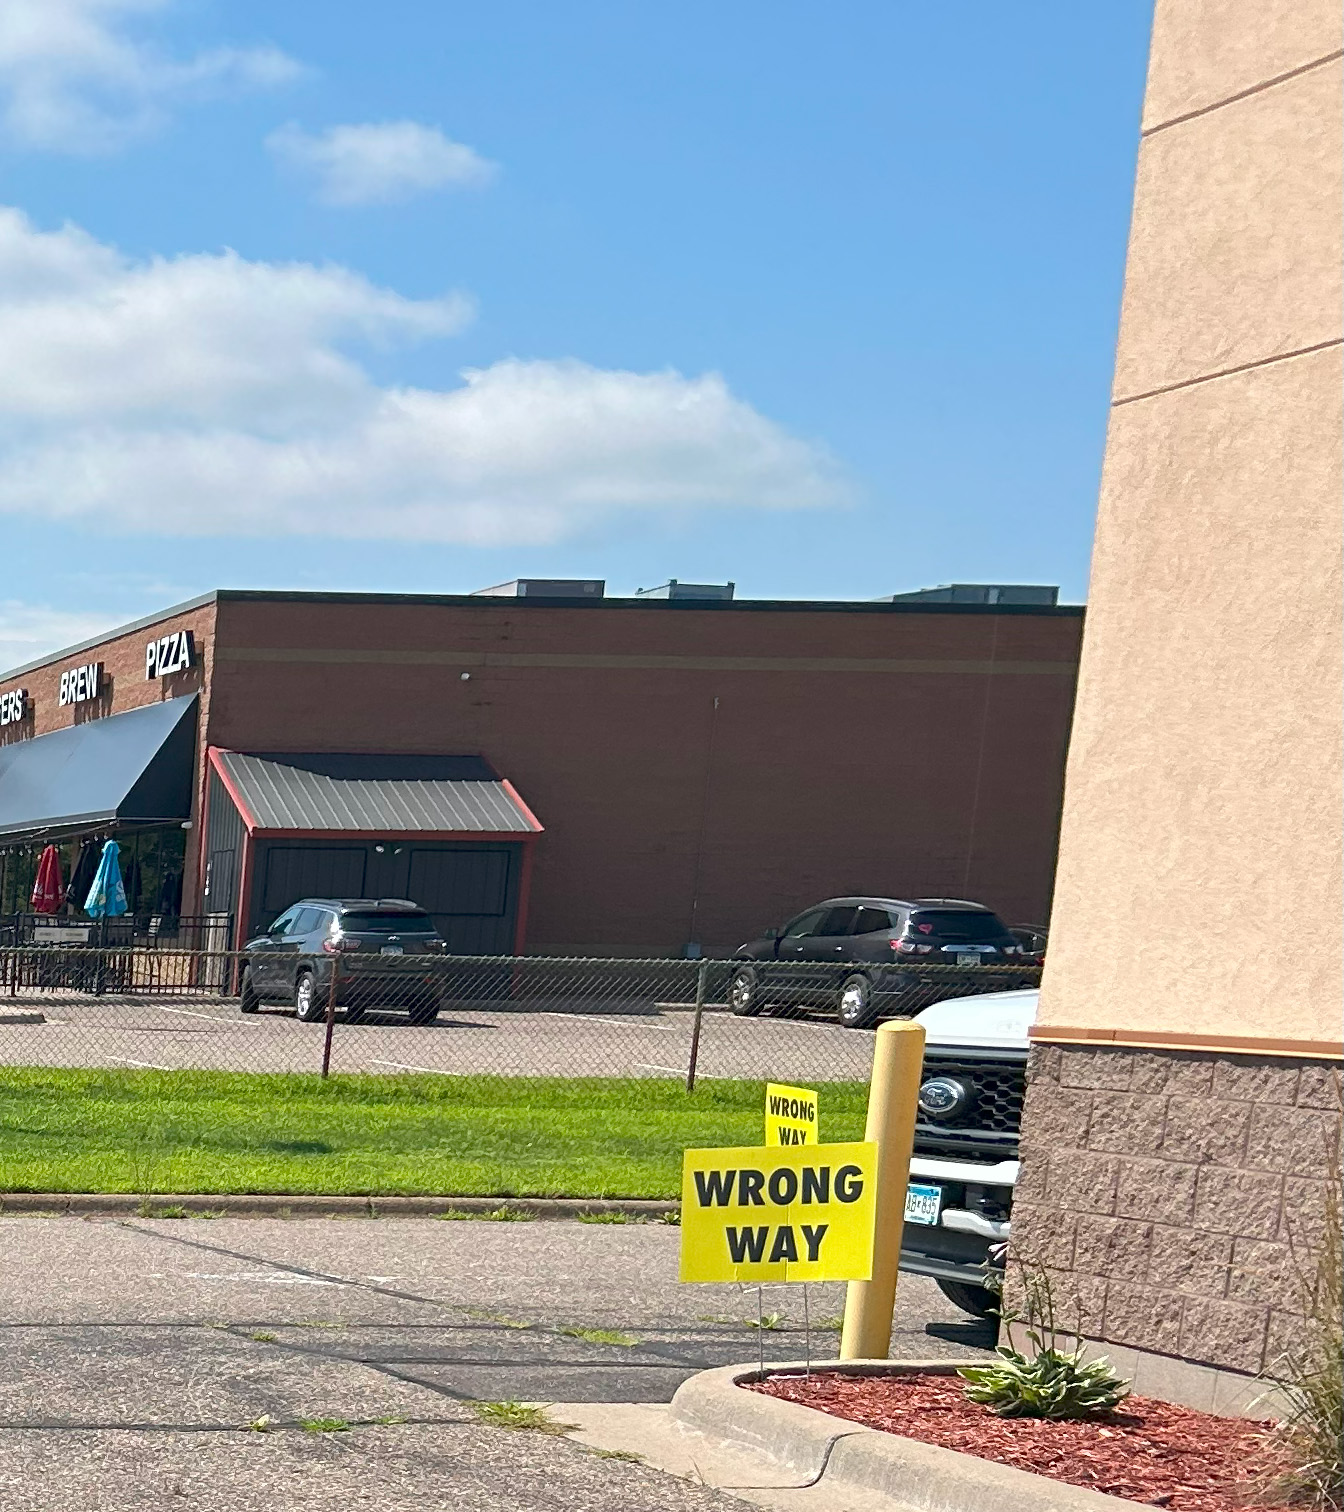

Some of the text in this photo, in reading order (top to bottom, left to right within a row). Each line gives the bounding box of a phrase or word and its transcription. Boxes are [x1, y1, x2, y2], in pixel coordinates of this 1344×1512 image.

[59, 662, 100, 707] BREW
[145, 631, 191, 680] PIZZA
[769, 1094, 815, 1122] WRONG
[778, 1126, 807, 1146] WAY
[693, 1164, 864, 1208] WRONG
[725, 1223, 830, 1264] WAY
